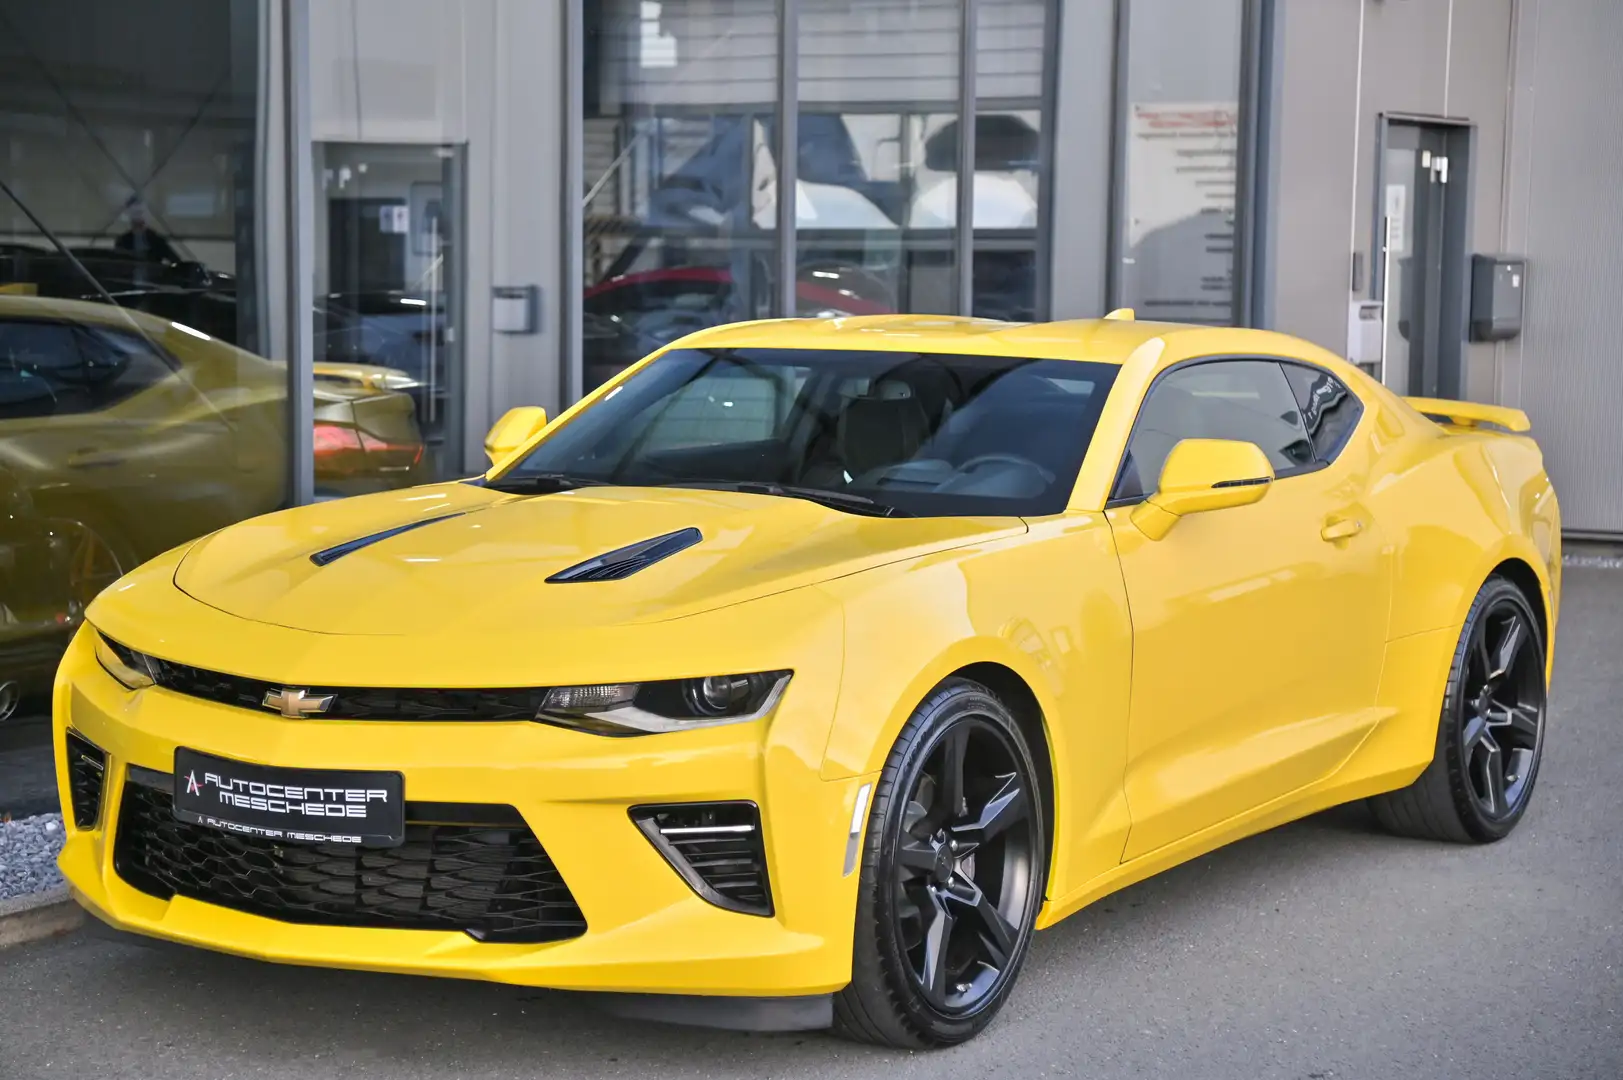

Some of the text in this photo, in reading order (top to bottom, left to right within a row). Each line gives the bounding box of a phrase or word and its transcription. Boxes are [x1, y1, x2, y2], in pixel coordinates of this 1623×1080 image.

[204, 772, 388, 803] AUTOCENTER
[219, 790, 367, 818] MESCHEDE
[206, 817, 283, 838] AUTOCENTER
[286, 831, 362, 844] MESCHEDE
